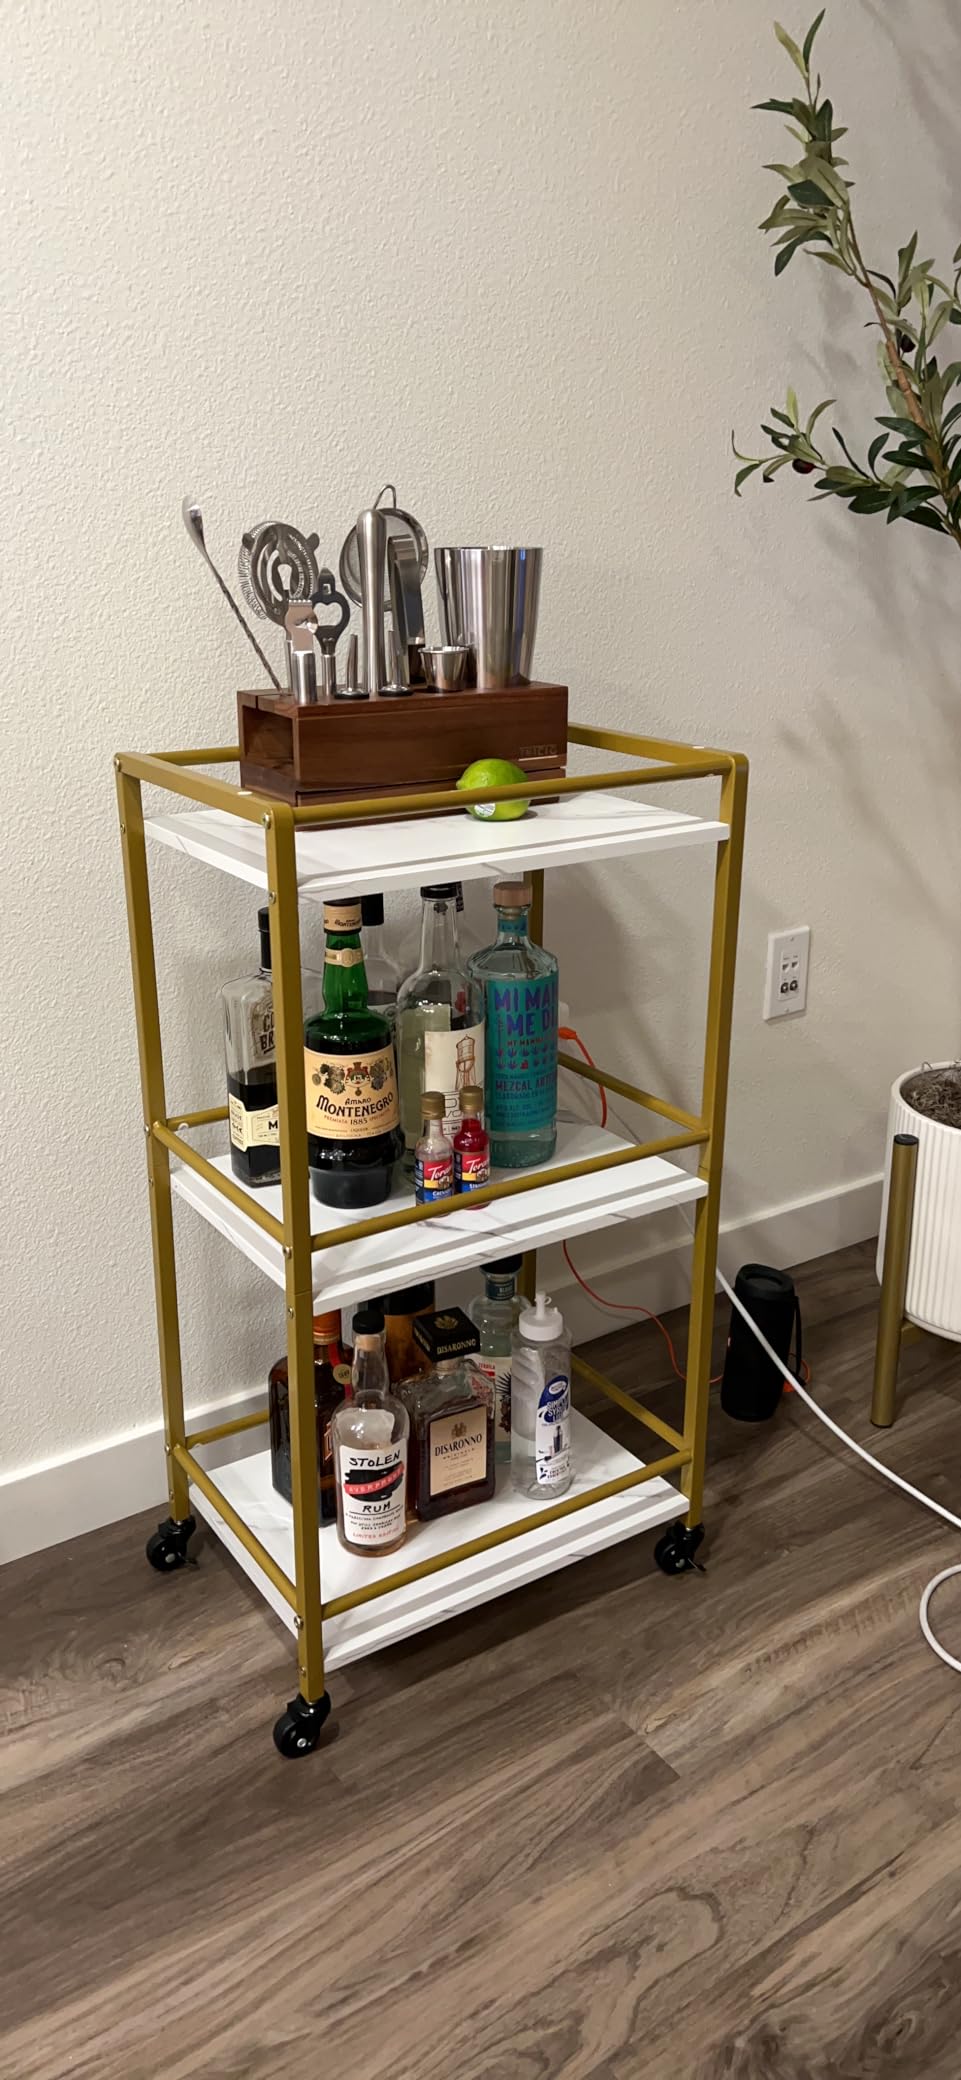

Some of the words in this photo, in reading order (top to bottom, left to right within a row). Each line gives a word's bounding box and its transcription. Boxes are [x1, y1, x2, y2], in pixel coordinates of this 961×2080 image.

[494, 987, 519, 1012] MI
[525, 984, 557, 1012] MA
[506, 1012, 536, 1036] ME
[495, 1079, 533, 1092] MEZCAL
[316, 1091, 394, 1118] MONTENEGRO
[344, 1097, 372, 1106] AMARO
[350, 1118, 368, 1126] 1885
[436, 1338, 477, 1355] DISARONNO
[434, 1433, 483, 1457] DISARONNO
[349, 1449, 400, 1467] STOLEN
[362, 1500, 391, 1513] RUM
